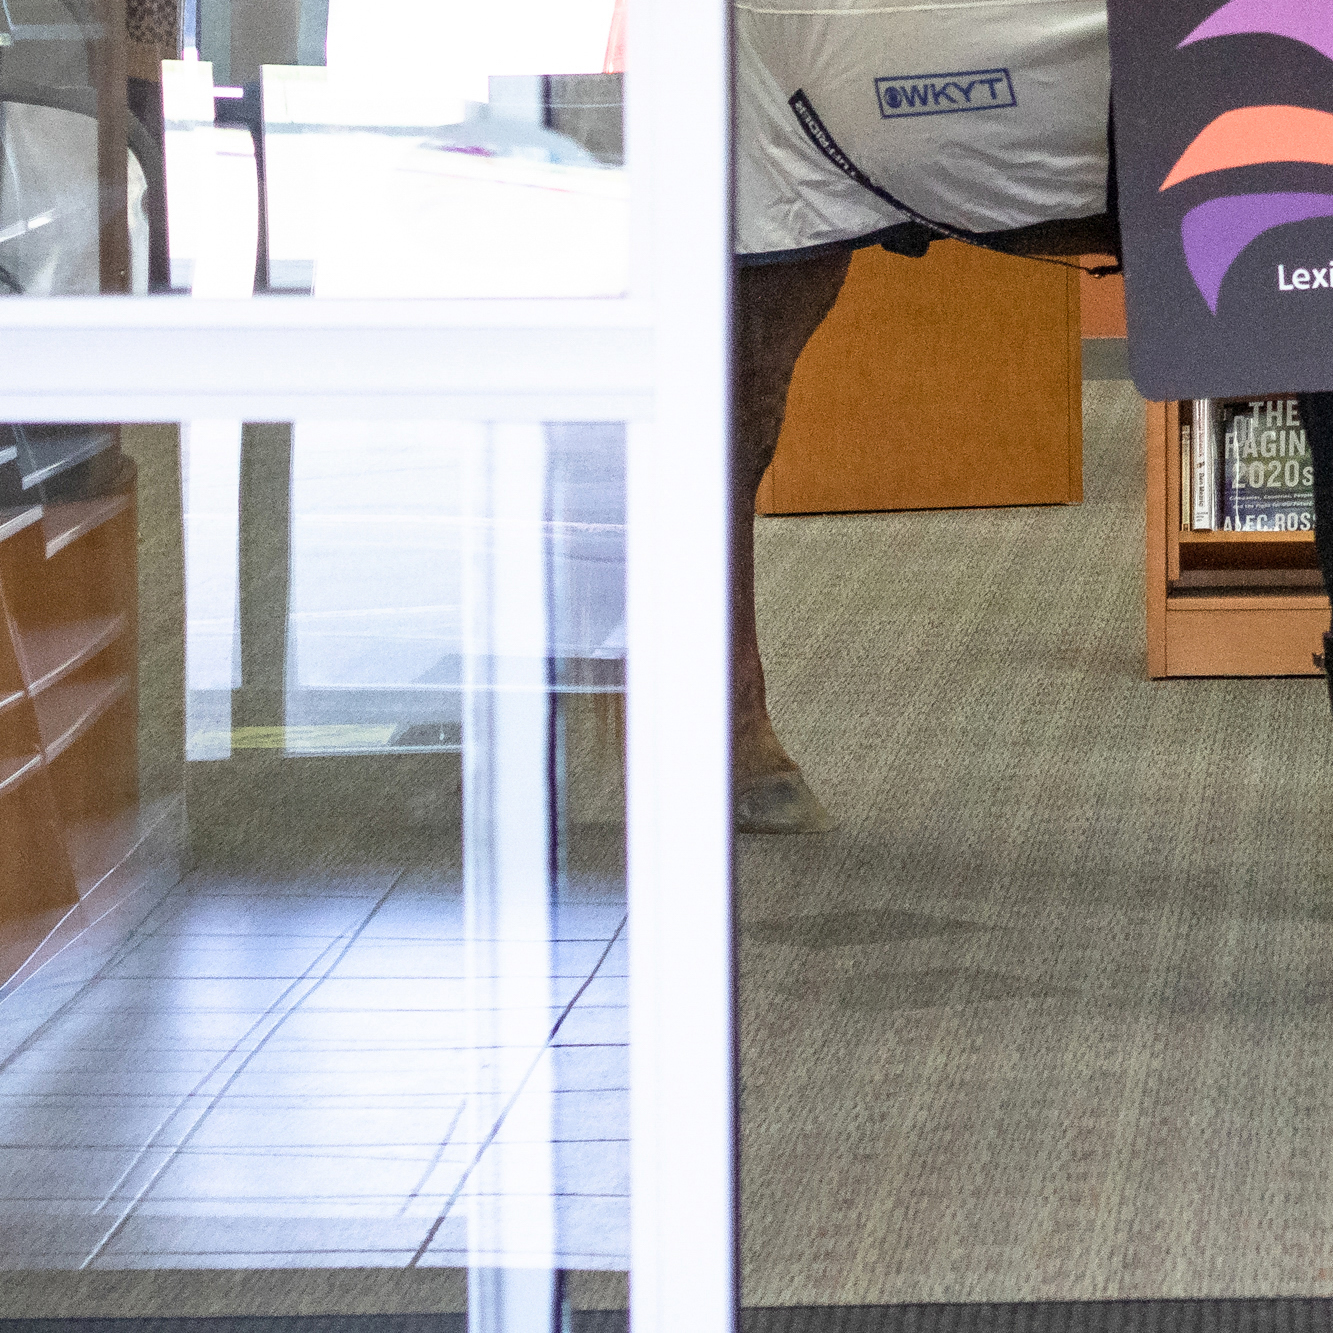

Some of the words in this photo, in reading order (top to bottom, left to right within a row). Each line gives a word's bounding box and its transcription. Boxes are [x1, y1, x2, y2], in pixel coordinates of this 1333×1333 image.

[901, 77, 1004, 108] WKYT
[1248, 399, 1301, 427] THE
[1231, 459, 1314, 489] 2020s
